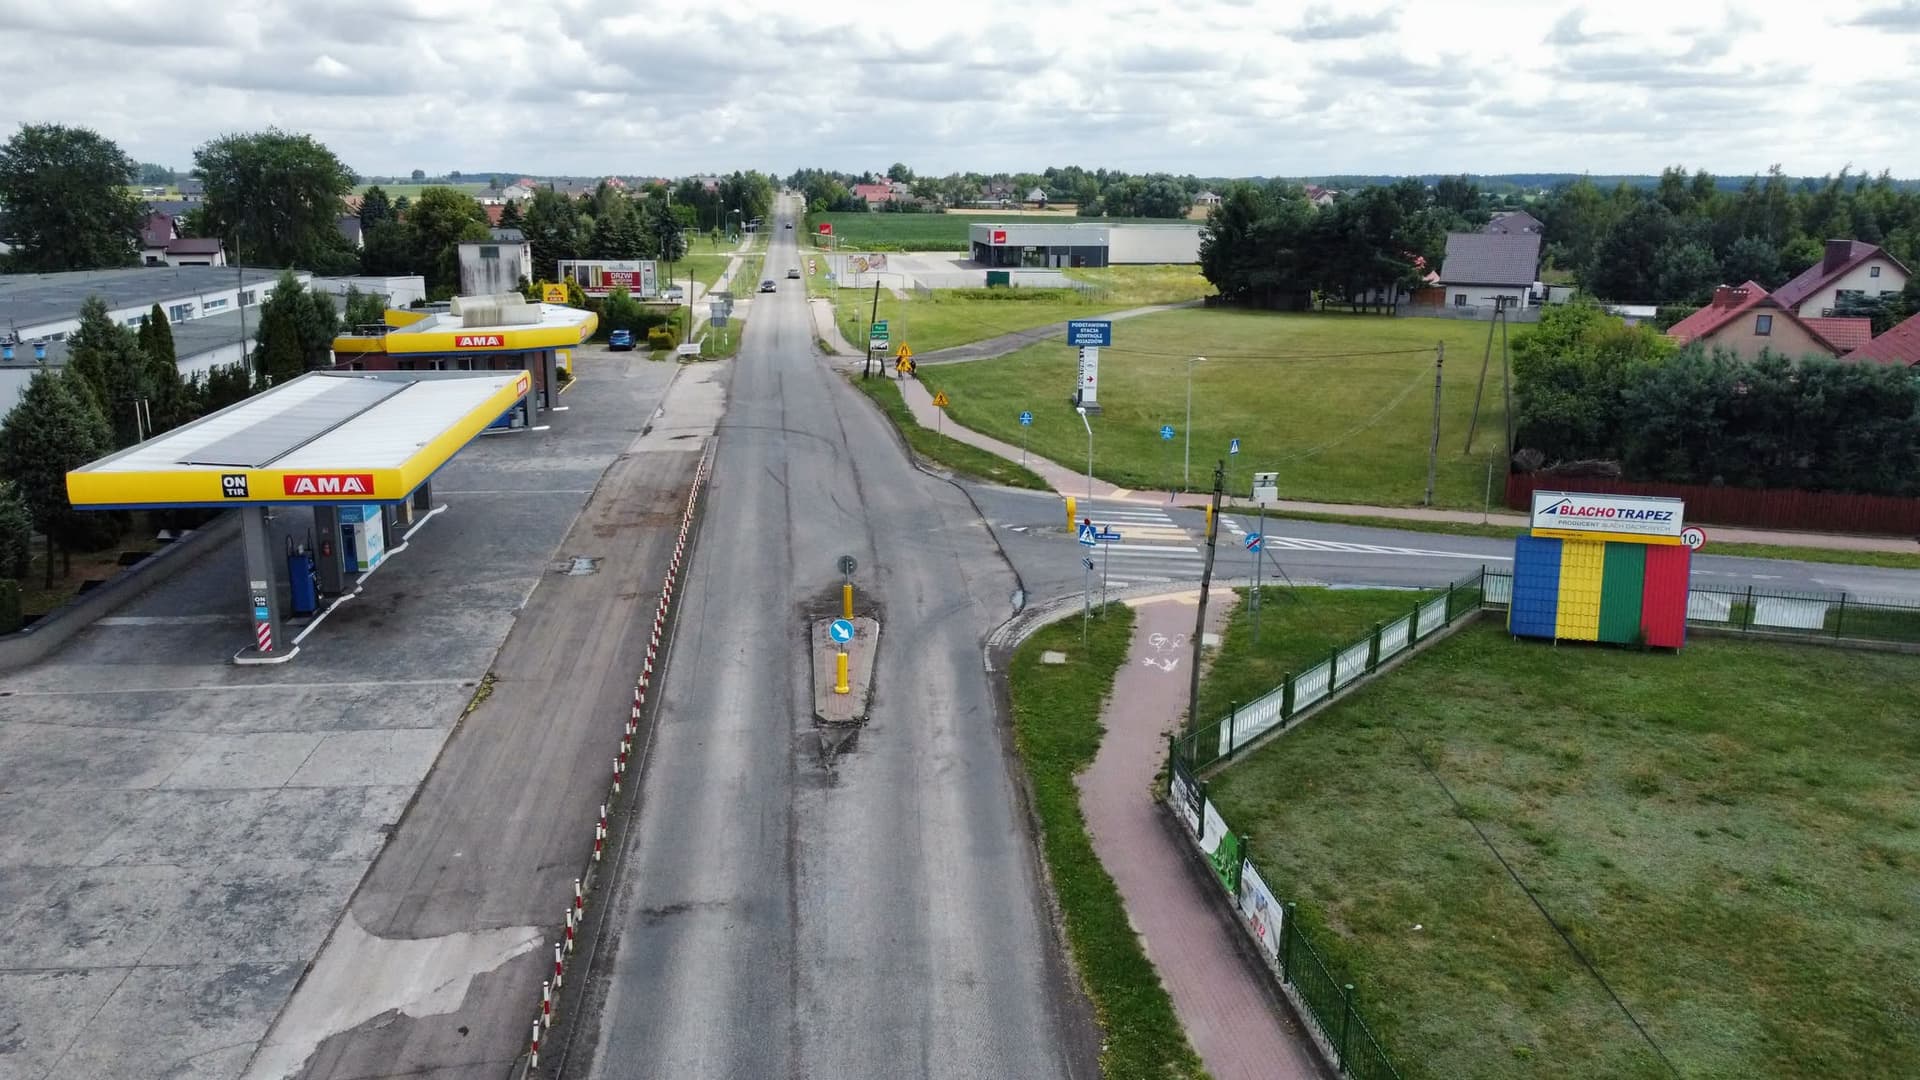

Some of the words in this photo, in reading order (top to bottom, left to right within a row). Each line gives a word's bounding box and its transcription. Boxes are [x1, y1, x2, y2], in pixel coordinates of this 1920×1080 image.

[460, 336, 499, 346] AMA
[223, 476, 247, 488] ON
[294, 477, 366, 493] AMA
[226, 488, 246, 496] TIR
[1558, 519, 1600, 528] PRODUCENT
